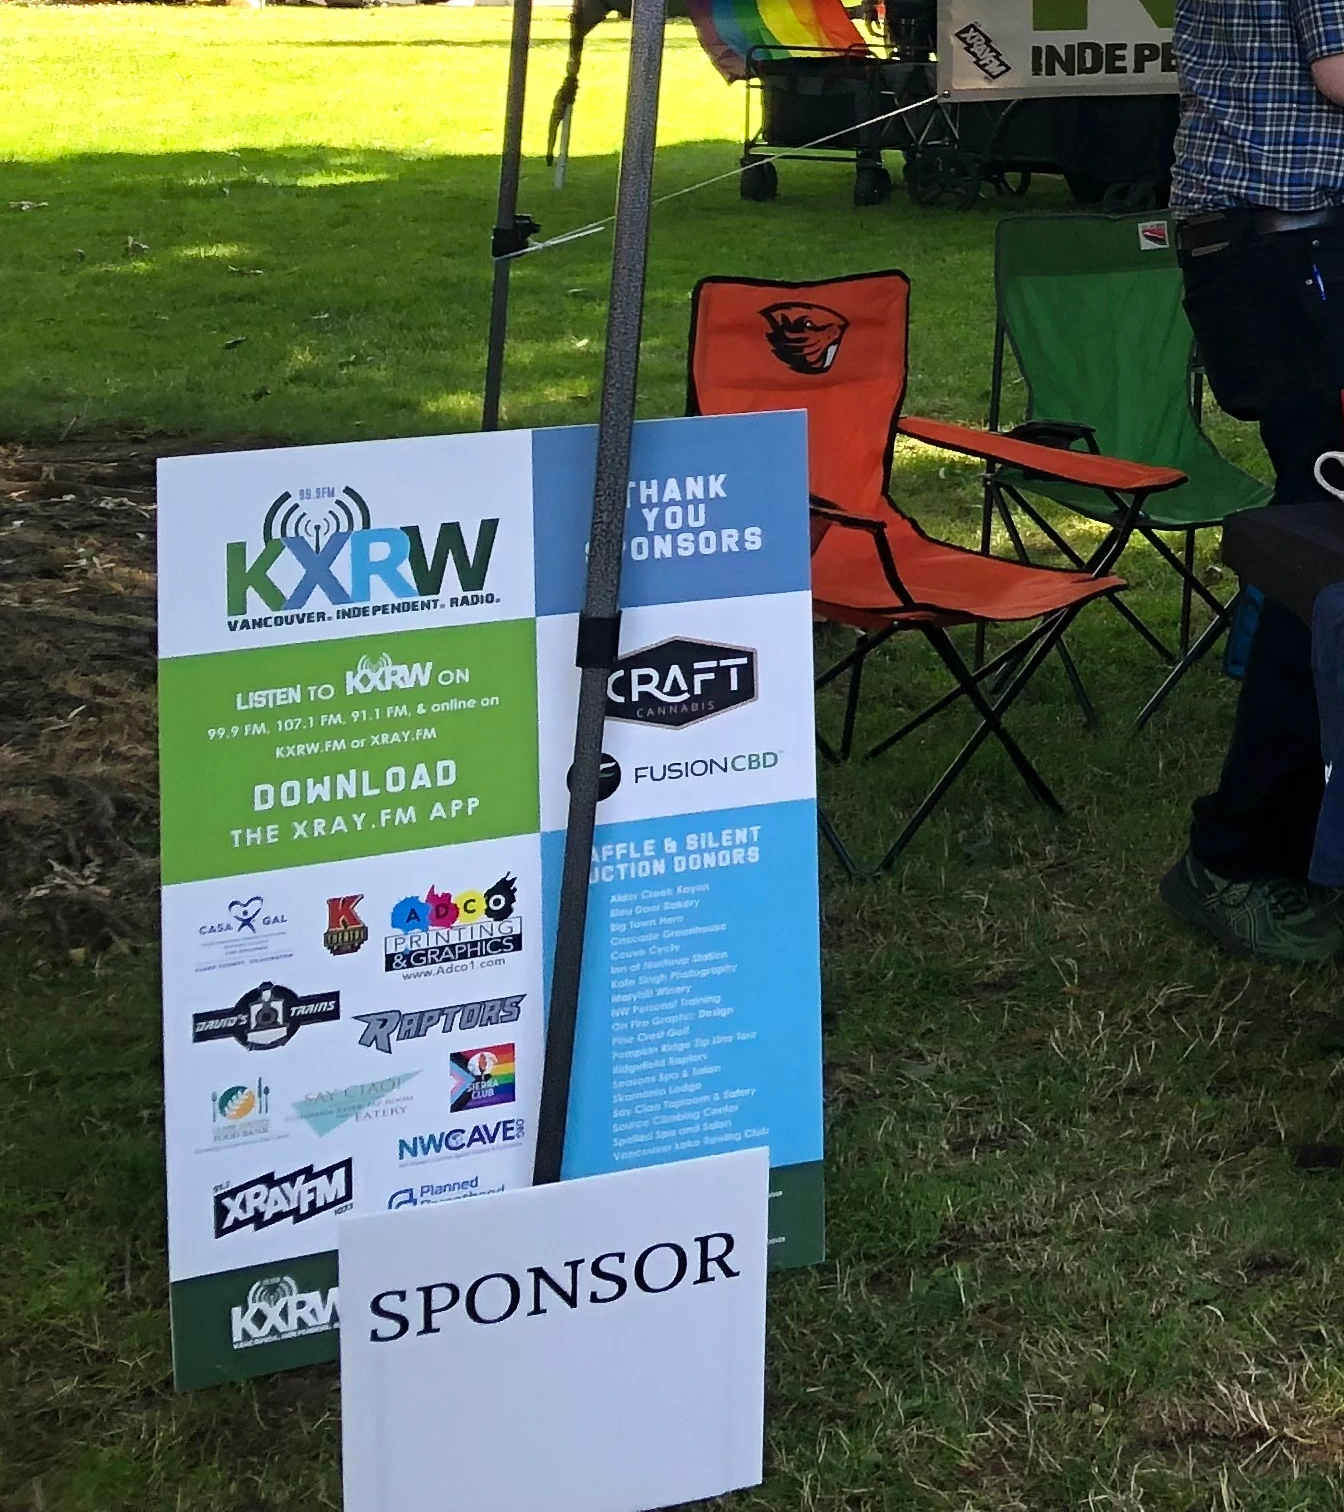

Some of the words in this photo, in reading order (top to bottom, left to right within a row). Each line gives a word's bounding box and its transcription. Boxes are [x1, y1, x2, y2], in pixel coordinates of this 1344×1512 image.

[627, 473, 727, 509] THANK
[642, 503, 707, 532] YOU
[226, 518, 500, 617] KXRW
[227, 610, 332, 632] VANCOUVER.
[336, 599, 446, 621] INDEPENDENT.
[449, 593, 501, 609] RADIO.
[236, 685, 301, 712] LISTEN
[308, 683, 334, 702] TO
[346, 662, 433, 696] KXRW
[438, 668, 470, 687] ON
[606, 656, 748, 703] CRAFT
[208, 725, 240, 741] 99.9
[276, 716, 315, 732] 107.1
[351, 707, 382, 724] 91.1
[417, 703, 427, 715] &
[431, 697, 476, 713] online
[480, 694, 500, 708] on
[636, 700, 715, 719] CANNABIS
[275, 738, 347, 760] KXRW.FM
[350, 737, 366, 750] or
[370, 727, 437, 748] XRAY.FM
[254, 759, 457, 812] DOWNLOAD
[230, 824, 279, 849] THE
[292, 804, 417, 840] XRAY.FM
[429, 797, 481, 822] APP
[591, 839, 656, 863] AFFLE
[686, 825, 762, 851] SILENT
[589, 858, 666, 885] UCTION
[673, 846, 760, 874] DONORS
[199, 922, 233, 935] CASA
[262, 915, 287, 926] GAL
[393, 919, 514, 953] PRINTING
[471, 1088, 495, 1100] CLUB
[355, 1105, 408, 1122] EATERY
[399, 1119, 515, 1160] NWCAVE
[420, 1176, 478, 1197] Planned
[369, 1231, 740, 1343] SPONSOR
